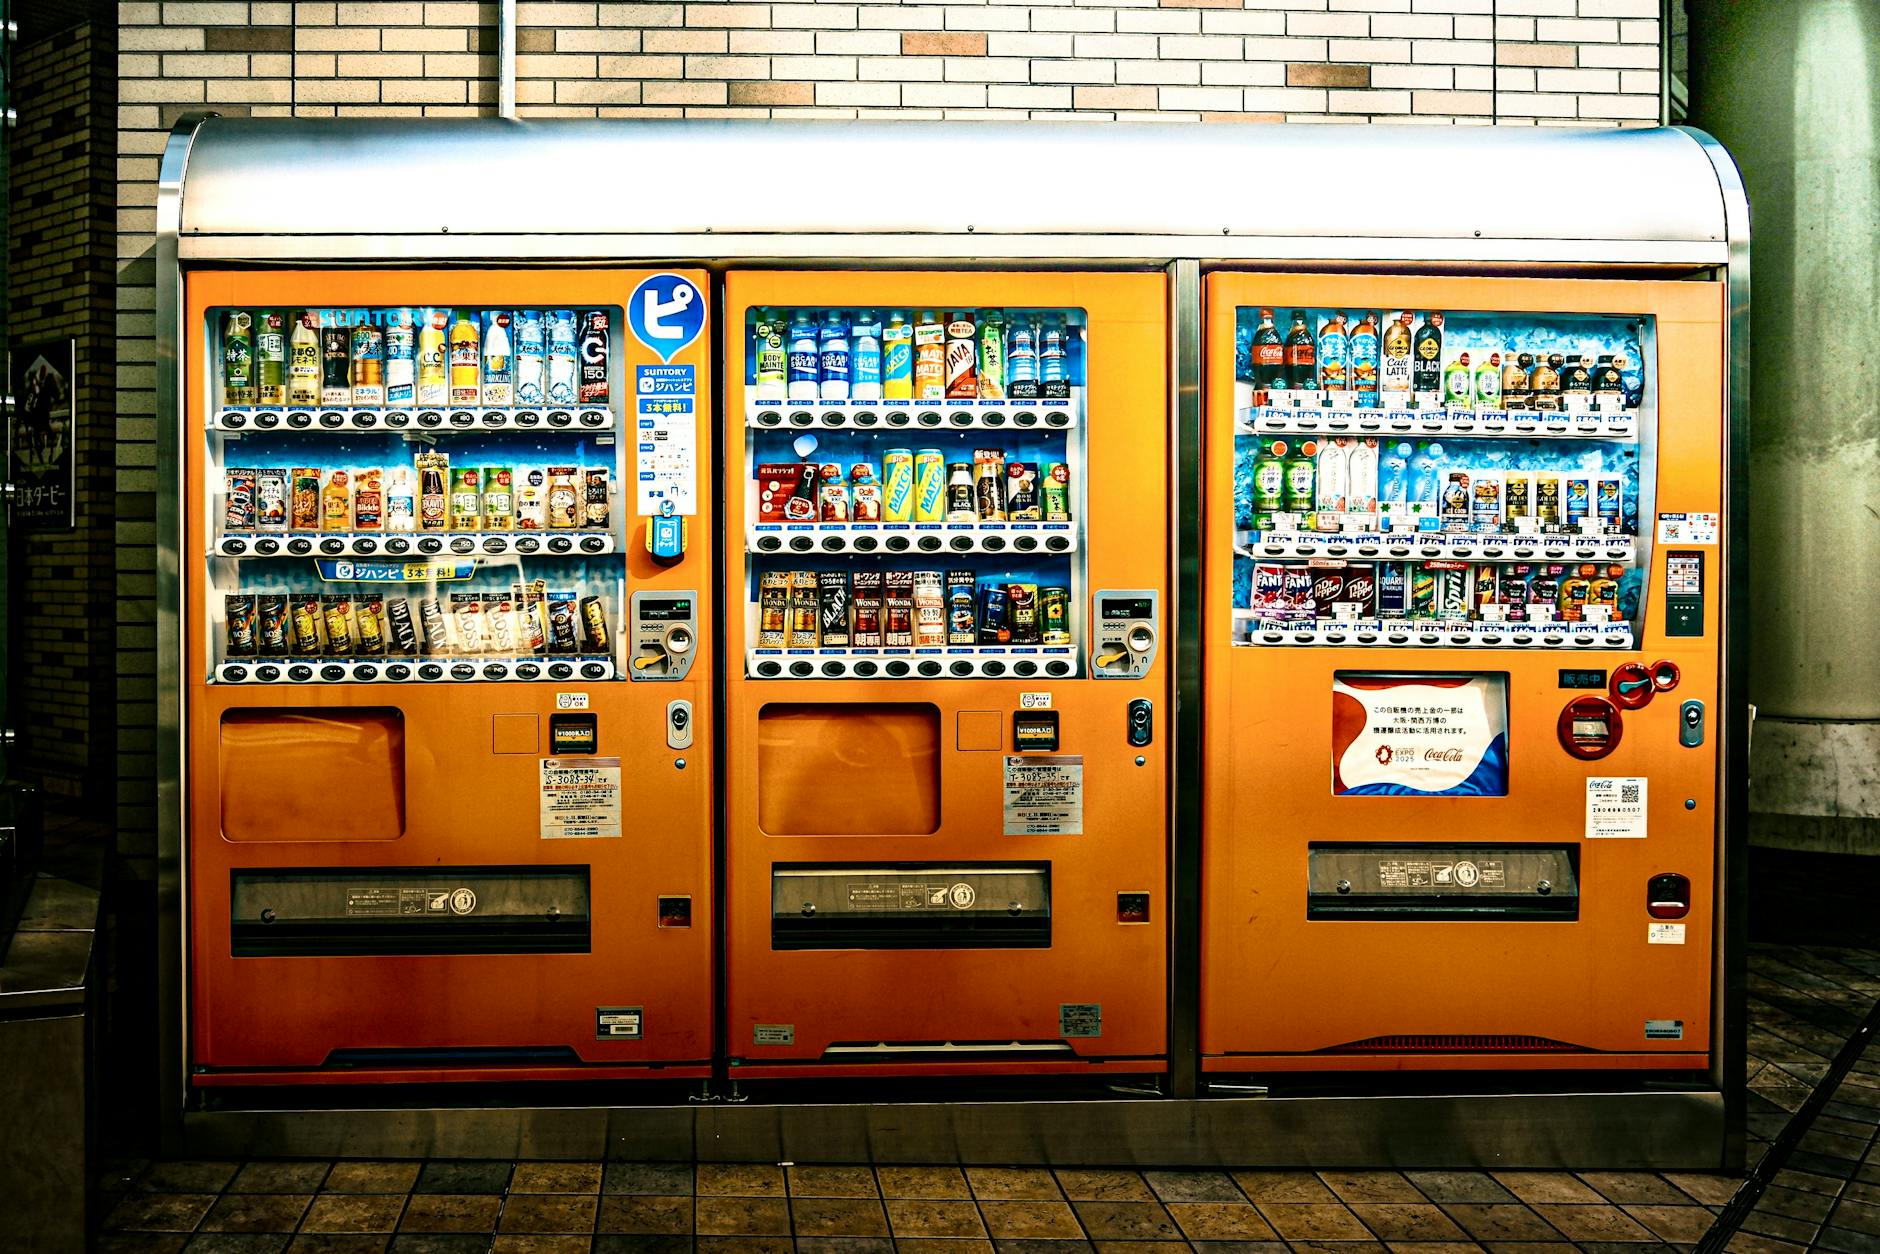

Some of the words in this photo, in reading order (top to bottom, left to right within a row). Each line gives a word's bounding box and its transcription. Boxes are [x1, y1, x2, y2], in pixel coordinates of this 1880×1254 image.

[226, 348, 249, 361] 特茶
[763, 354, 782, 362] BODY
[947, 343, 971, 375] JAVA
[1387, 357, 1408, 367] Café
[1414, 360, 1440, 372] BLACK
[644, 368, 687, 376] SUNTORY
[1386, 367, 1408, 376] LATTE
[828, 488, 844, 497] Dole
[859, 488, 875, 497] Dole
[888, 464, 912, 515] MATCH
[920, 464, 943, 515] MATCH
[16, 486, 65, 507] 日本ダービー
[357, 504, 379, 512] Bikkle
[1257, 574, 1283, 587] FANT
[1321, 579, 1333, 588] Dr
[1356, 579, 1368, 588] Dr
[1315, 583, 1340, 598] Pepper
[1349, 583, 1373, 598] Pepper
[763, 598, 786, 607] WONDA
[793, 598, 818, 607] WONDA
[823, 586, 847, 629] BLACK
[855, 598, 880, 607] WONDA
[887, 598, 912, 607] WONDA
[391, 599, 415, 650] BLACK
[424, 599, 446, 649] BLACK
[1563, 673, 1601, 685] 販売中
[1373, 706, 1464, 714] この自販機の売上金の一部は
[1393, 716, 1447, 724] 大阪・関西万博の
[1424, 748, 1464, 762] Coca-Cola
